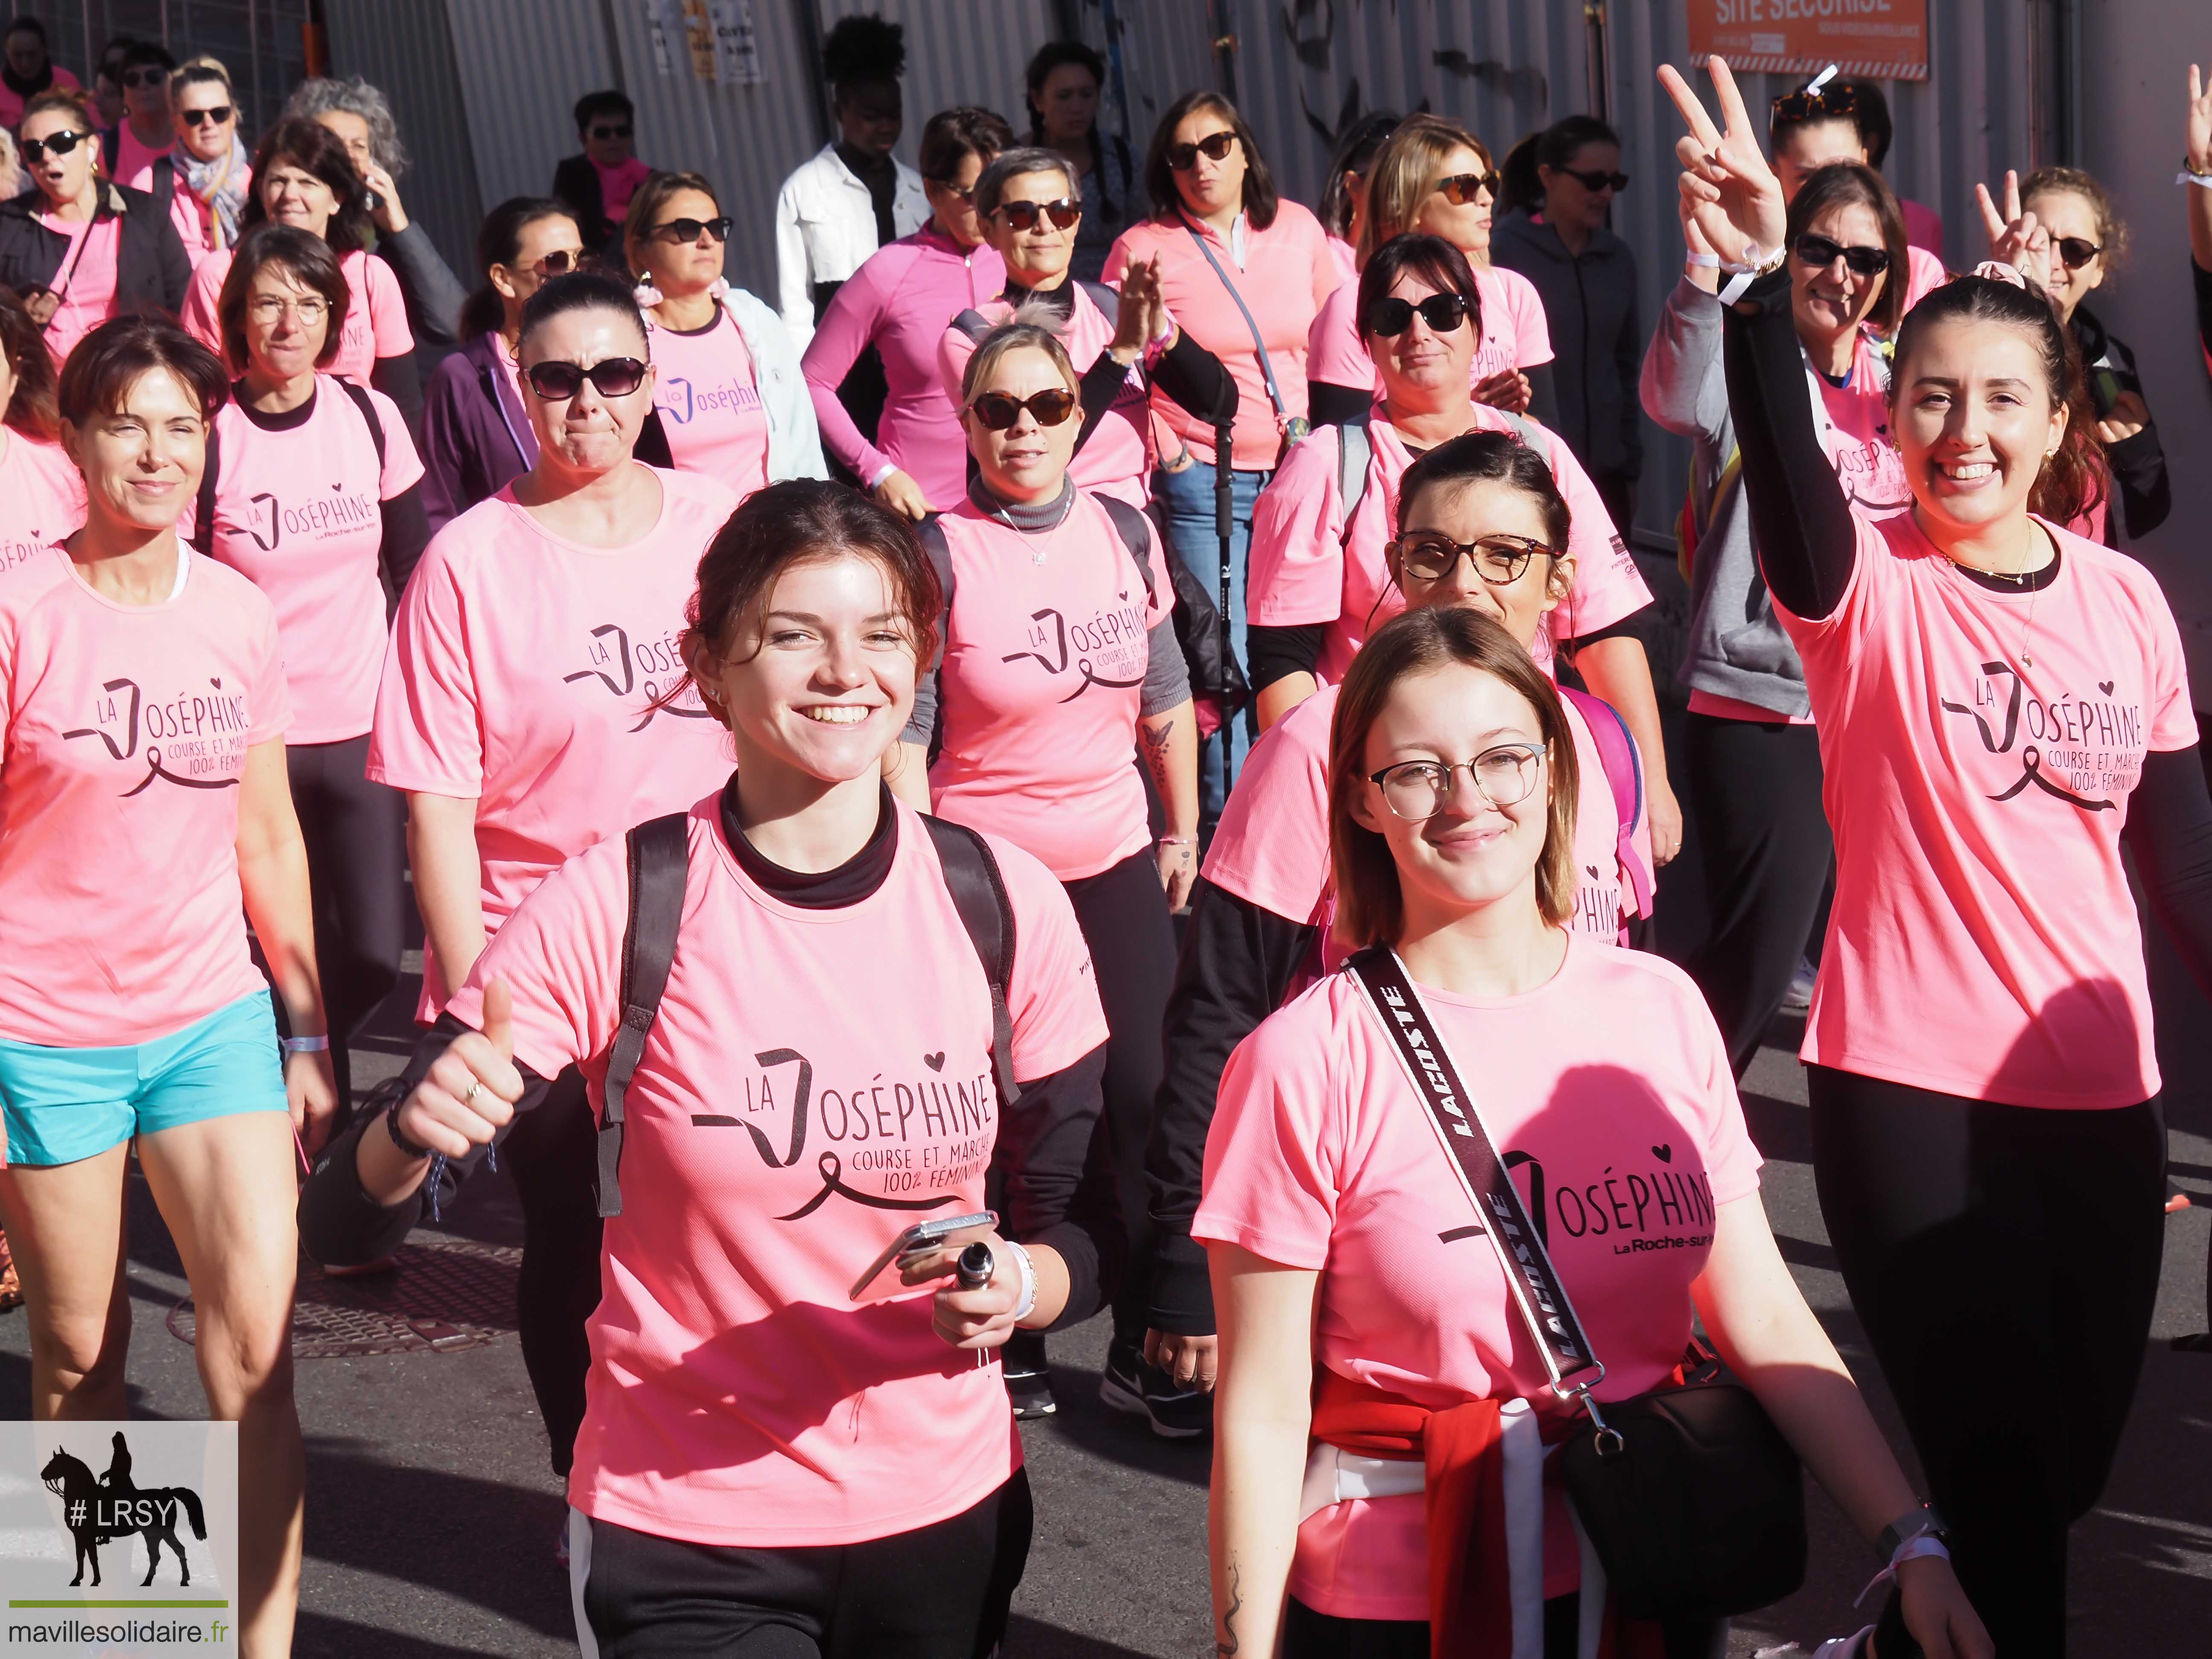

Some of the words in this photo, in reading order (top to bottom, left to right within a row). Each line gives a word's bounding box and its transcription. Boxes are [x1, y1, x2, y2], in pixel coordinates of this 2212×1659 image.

[226, 493, 373, 551] JOSÉPHINE
[246, 509, 264, 526] LA
[1028, 625, 1048, 647] LA
[588, 642, 611, 665] LA
[1097, 648, 1129, 666] COURSE
[1131, 643, 1139, 657] ET
[1976, 678, 1995, 707] LA
[62, 678, 248, 760] JOSÉPHINE
[97, 698, 117, 723] LA
[1941, 661, 2141, 754] JOSÉPHINE
[169, 741, 207, 759] COURSE
[212, 739, 223, 754] ET
[2049, 751, 2090, 769] COURSE
[2098, 753, 2109, 770] ET
[2115, 753, 2140, 770] MARCHE
[190, 757, 215, 775] 100%
[2069, 772, 2096, 790] 100%
[1380, 986, 1475, 1138] LACOSTE
[745, 1074, 774, 1112] LA
[691, 1048, 991, 1168] JOSÉPHINE
[853, 1149, 912, 1170] COURSE
[924, 1147, 940, 1168] ET
[950, 1132, 990, 1164] MARCHE
[884, 1171, 922, 1193] 100%
[1614, 1245, 1630, 1255] La
[1485, 1191, 1580, 1358] LACOSTE
